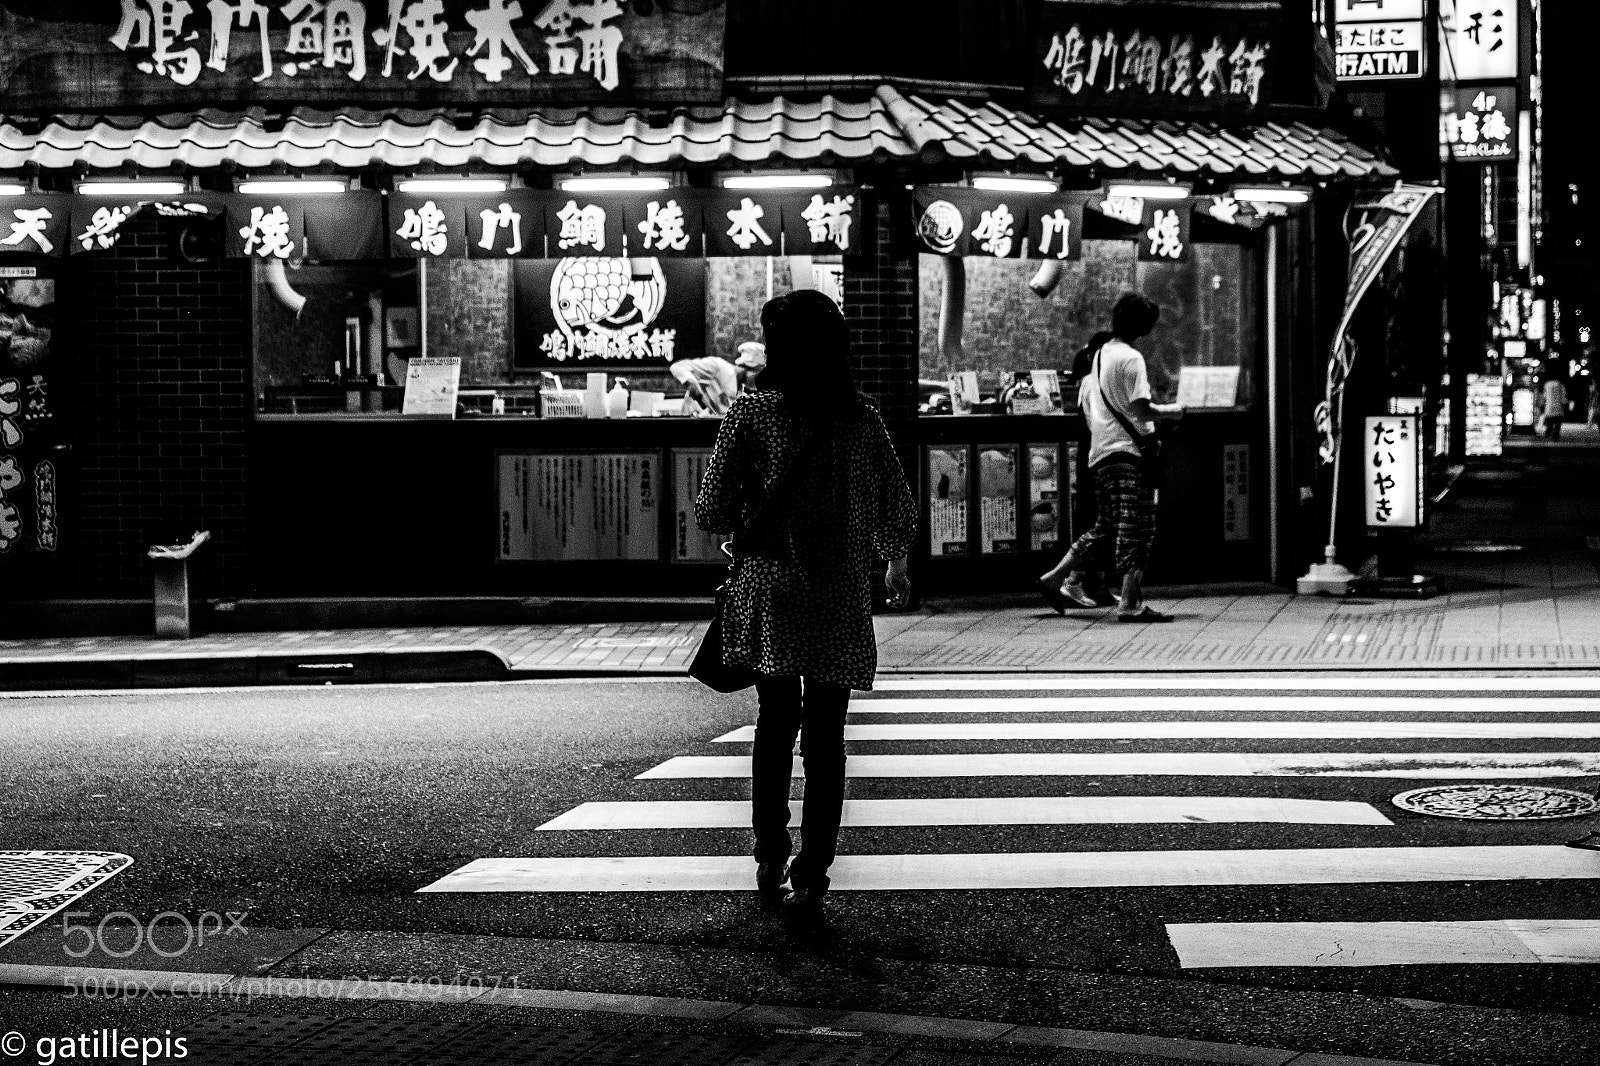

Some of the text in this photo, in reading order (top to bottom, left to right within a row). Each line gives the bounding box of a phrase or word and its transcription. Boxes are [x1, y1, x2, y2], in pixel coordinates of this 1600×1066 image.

[110, 0, 624, 91] 鳴門鯛焼本舗
[1043, 26, 1271, 106] 鳴門鯛焼本舗
[1335, 52, 1409, 76] 行ATM
[396, 194, 855, 257] 鳴門鯛焼本舗
[1372, 421, 1396, 522] たいやき
